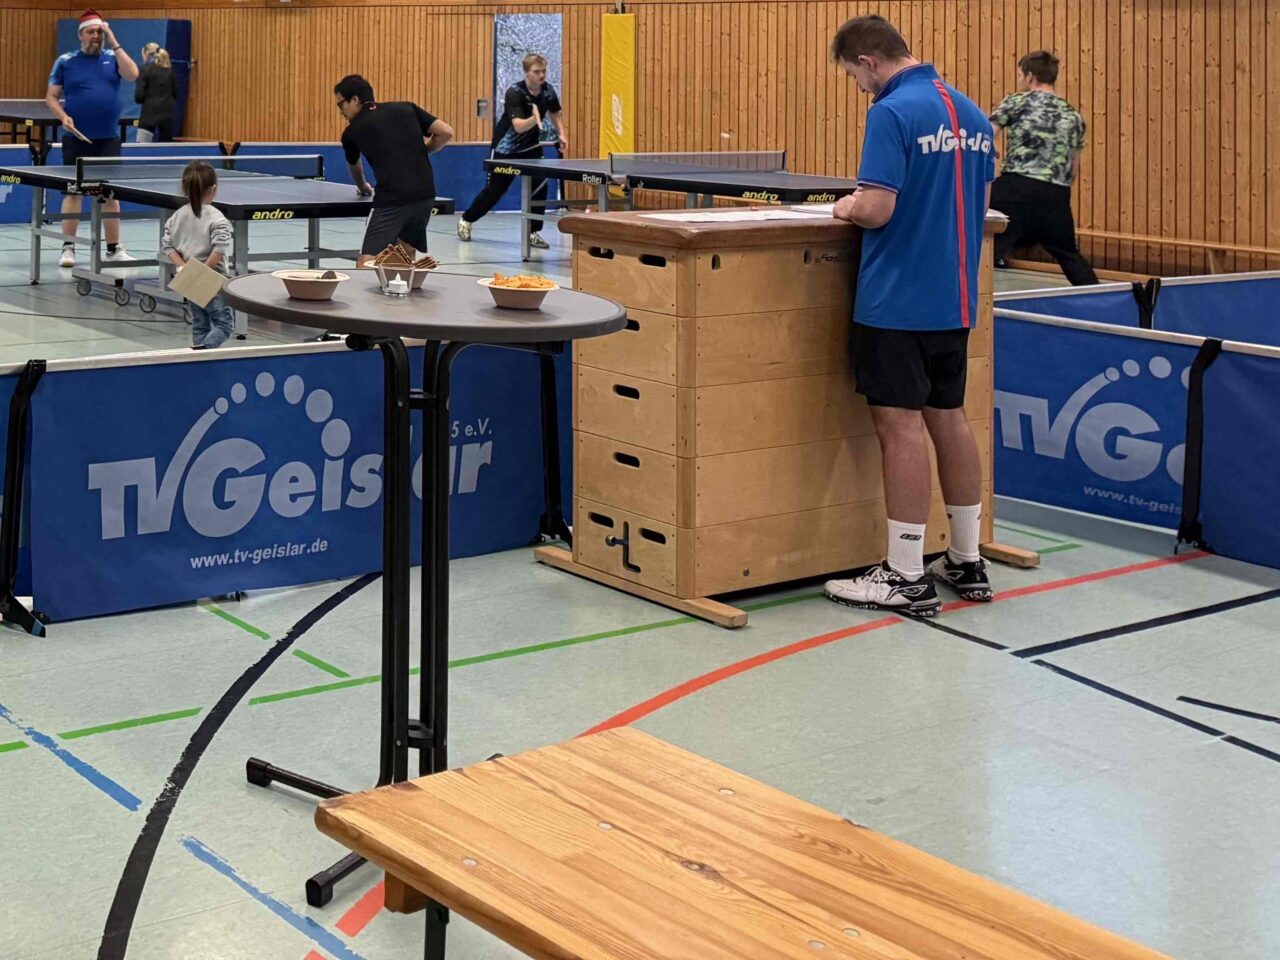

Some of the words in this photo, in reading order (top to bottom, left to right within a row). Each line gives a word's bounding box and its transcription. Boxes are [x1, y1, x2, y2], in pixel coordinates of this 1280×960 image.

[493, 166, 521, 176] andro
[0, 174, 21, 184] andro
[582, 173, 603, 184] Roller
[742, 191, 780, 201] andro
[807, 192, 836, 202] andro
[252, 208, 295, 220] andro
[464, 417, 492, 436] e.V.
[190, 538, 328, 570] www.tv-geislar.de
